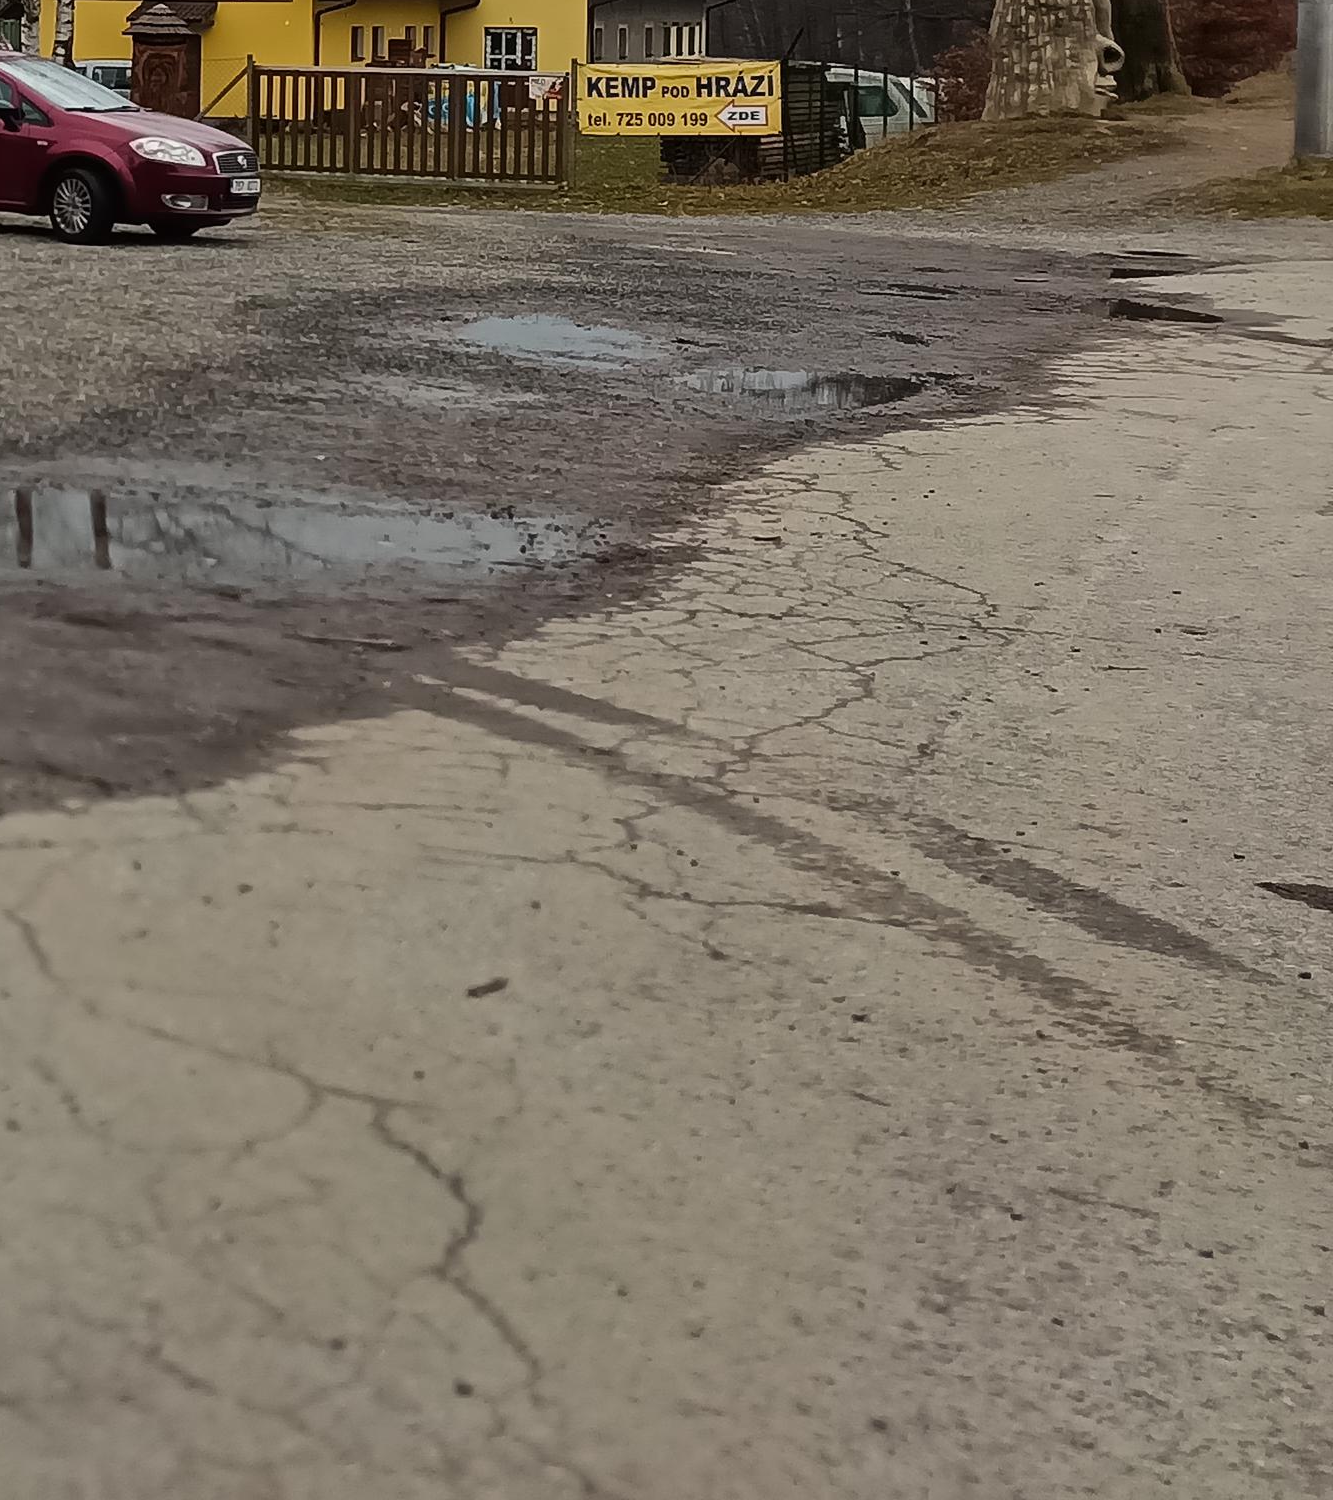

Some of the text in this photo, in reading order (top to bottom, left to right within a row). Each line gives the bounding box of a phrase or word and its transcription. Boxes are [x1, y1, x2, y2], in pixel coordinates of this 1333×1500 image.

[587, 70, 774, 98] KEMP POD HRÁZÍ
[587, 112, 708, 127] tel. 725 009 199
[727, 110, 760, 120] ZDE
